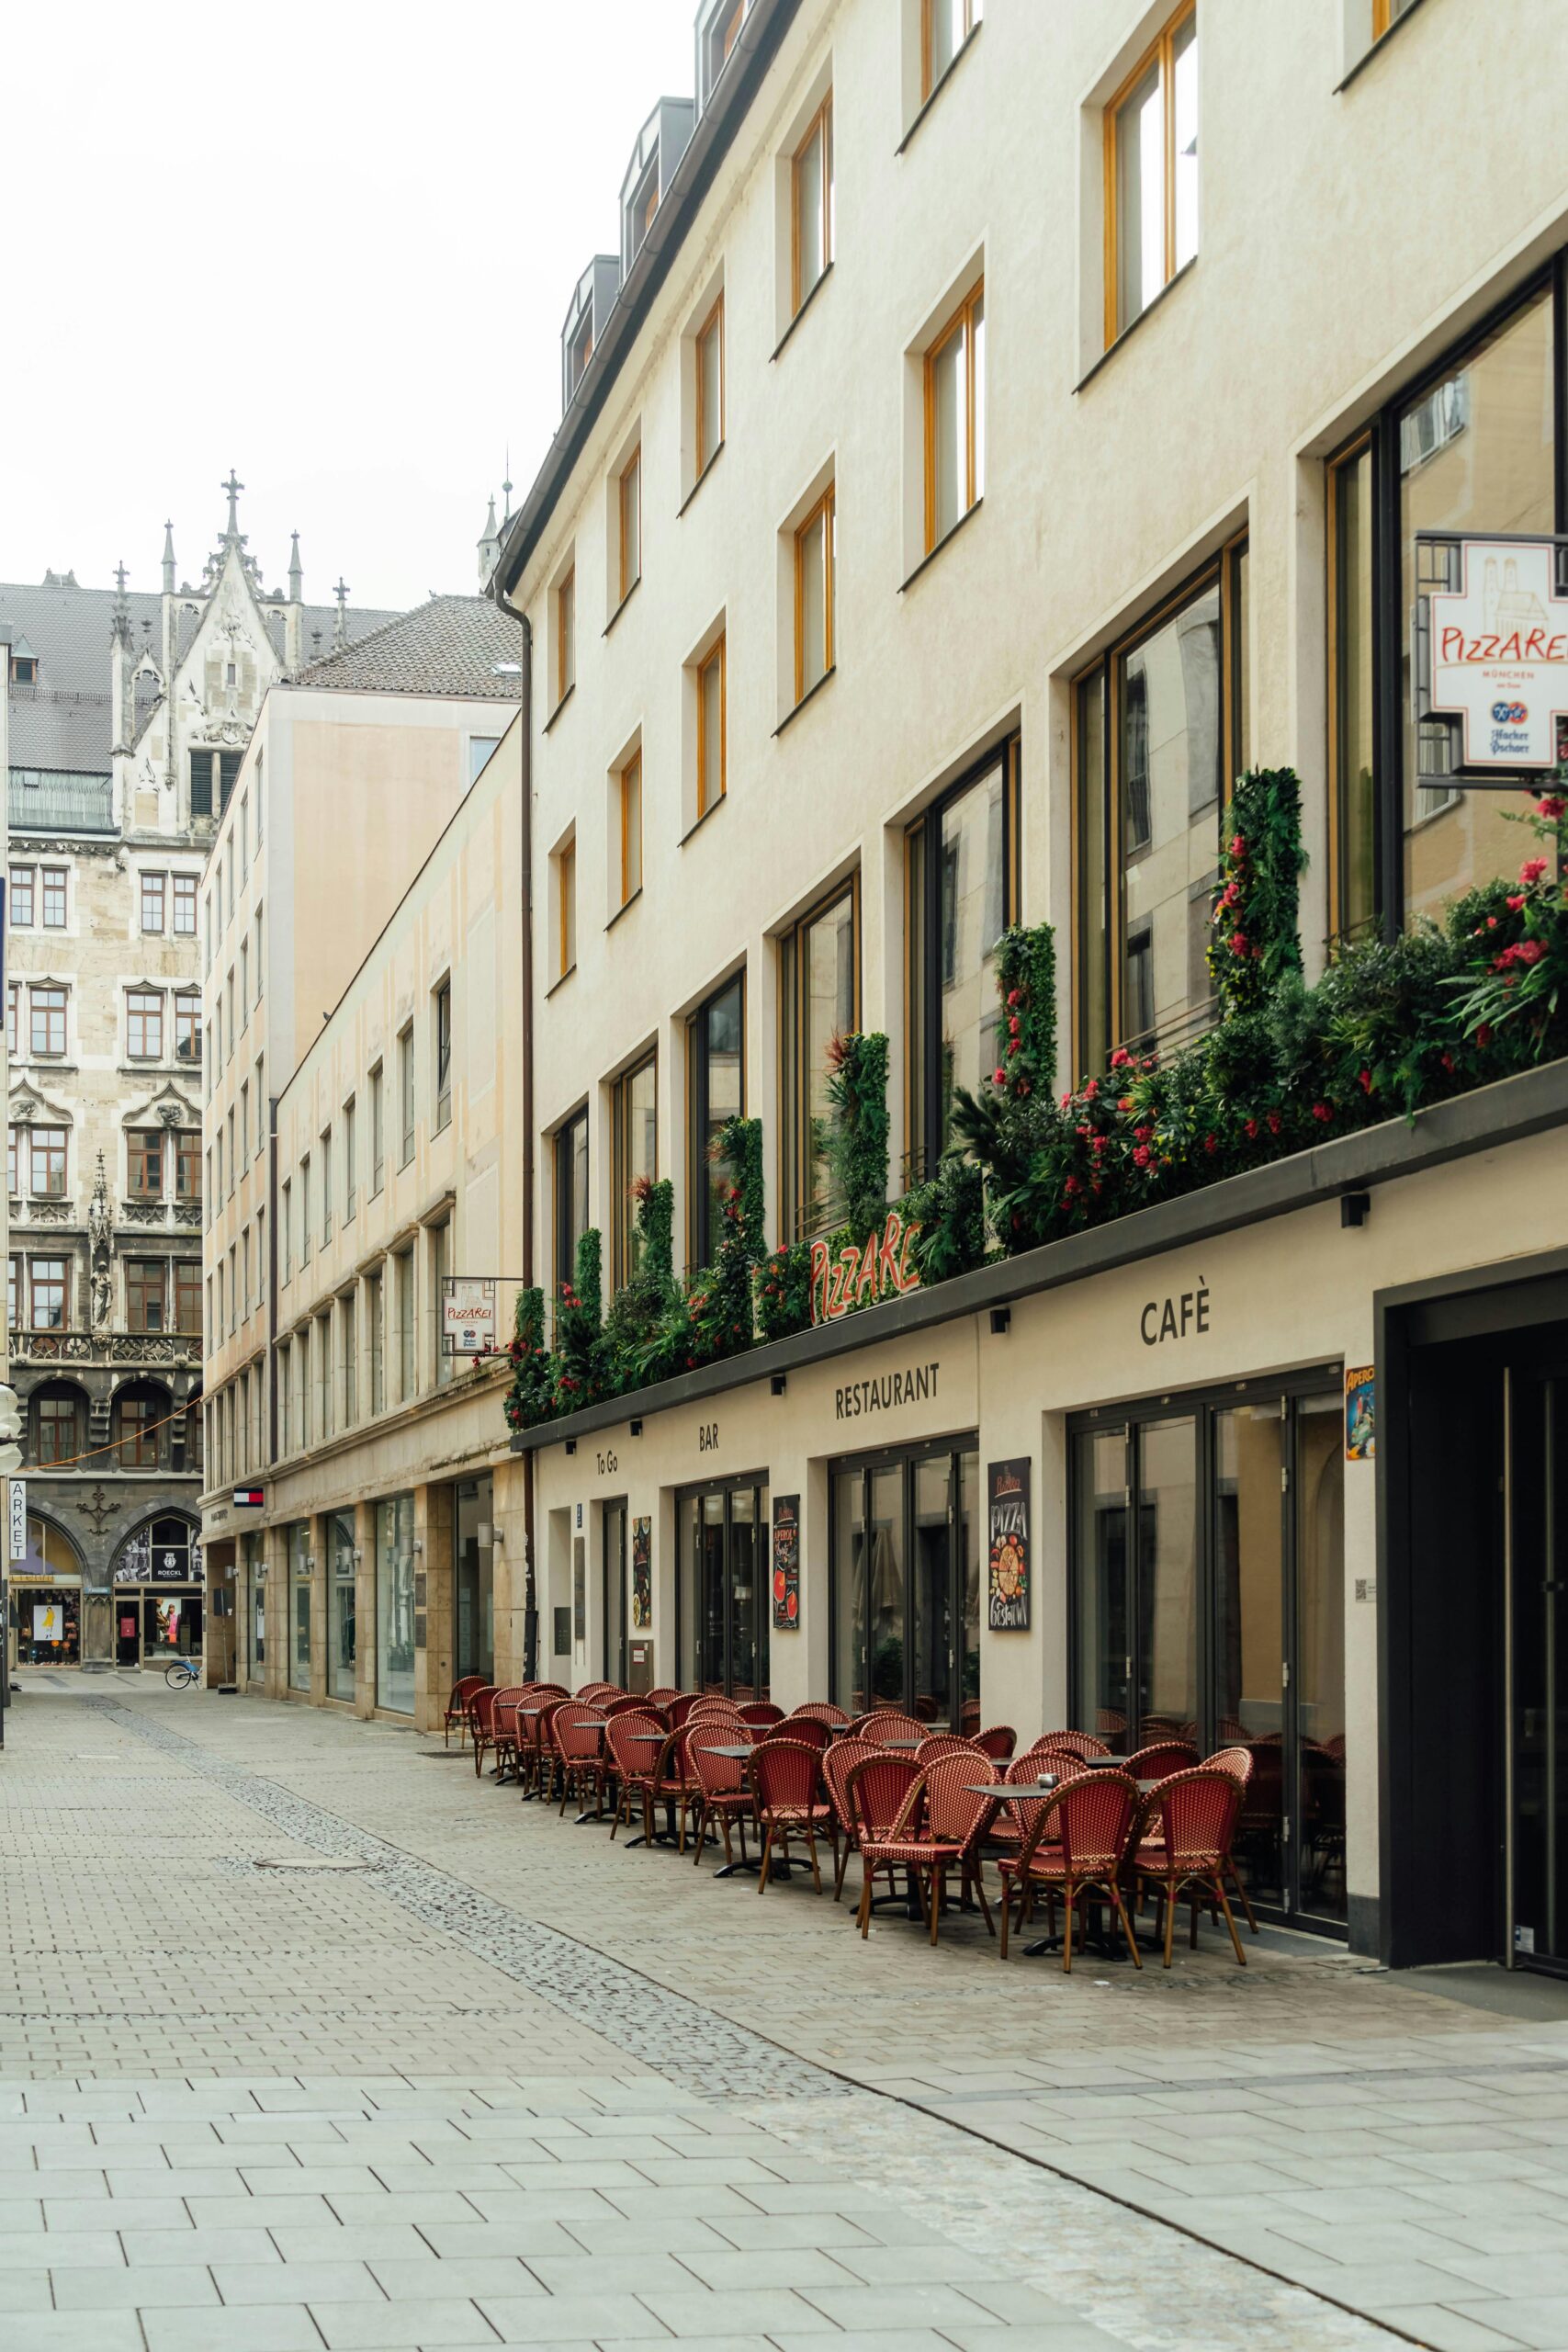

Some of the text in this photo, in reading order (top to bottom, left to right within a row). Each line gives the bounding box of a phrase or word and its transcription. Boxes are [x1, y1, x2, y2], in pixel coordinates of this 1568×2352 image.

[1441, 627, 1568, 662] PIZZARE
[1483, 669, 1534, 679] MÜNCHEN
[1491, 729, 1529, 741] Hacker
[809, 1212, 921, 1327] PIZZARE
[447, 1306, 491, 1319] PIZZAREI
[1141, 1275, 1210, 1346] CAFÈ
[836, 1363, 940, 1420] RESTAURANT
[1347, 1367, 1374, 1396] APERO
[699, 1423, 718, 1452] BAR
[597, 1450, 618, 1476] To Go
[13, 1483, 23, 1557] ARKET
[991, 1502, 1027, 1544] PIZZA
